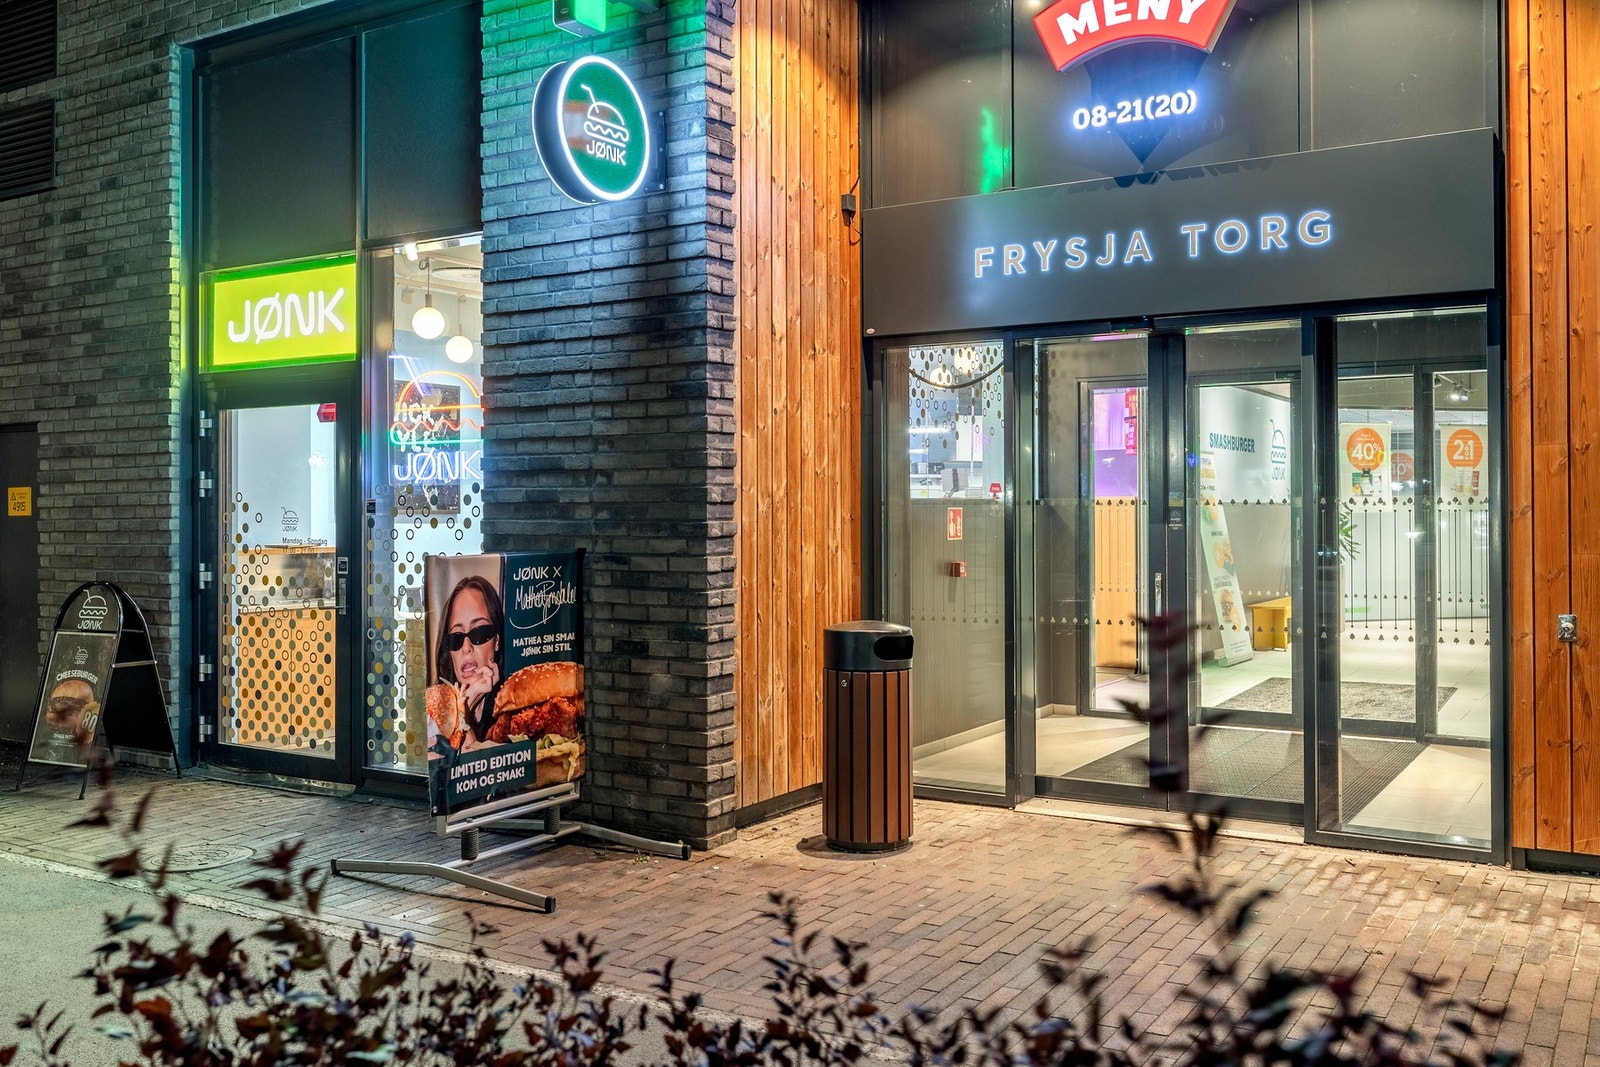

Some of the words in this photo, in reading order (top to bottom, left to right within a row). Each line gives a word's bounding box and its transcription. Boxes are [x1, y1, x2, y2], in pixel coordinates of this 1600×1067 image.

[1056, 0, 1203, 46] MENY
[586, 139, 627, 167] JØNK
[975, 230, 1152, 278] FRYSJA
[1182, 210, 1331, 257] TORG
[227, 287, 345, 345] JØNK
[1209, 432, 1256, 454] SMASHBURGER
[1351, 442, 1382, 461] 40%
[1453, 439, 1465, 461] 2
[394, 449, 483, 484] JØNK
[513, 566, 549, 581] JØNK
[77, 620, 103, 630] JØNK
[512, 635, 542, 648] MATHEA
[542, 633, 555, 644] SIN
[520, 646, 541, 658] JØNK
[542, 644, 554, 653] SIN
[554, 642, 572, 652] STIL
[56, 669, 99, 685] CHEESEBURGER
[450, 759, 488, 780] LIMITED
[490, 749, 532, 770] EDITION
[456, 779, 478, 794] KOM
[479, 773, 495, 788] OG
[496, 766, 525, 783] SMAK!
